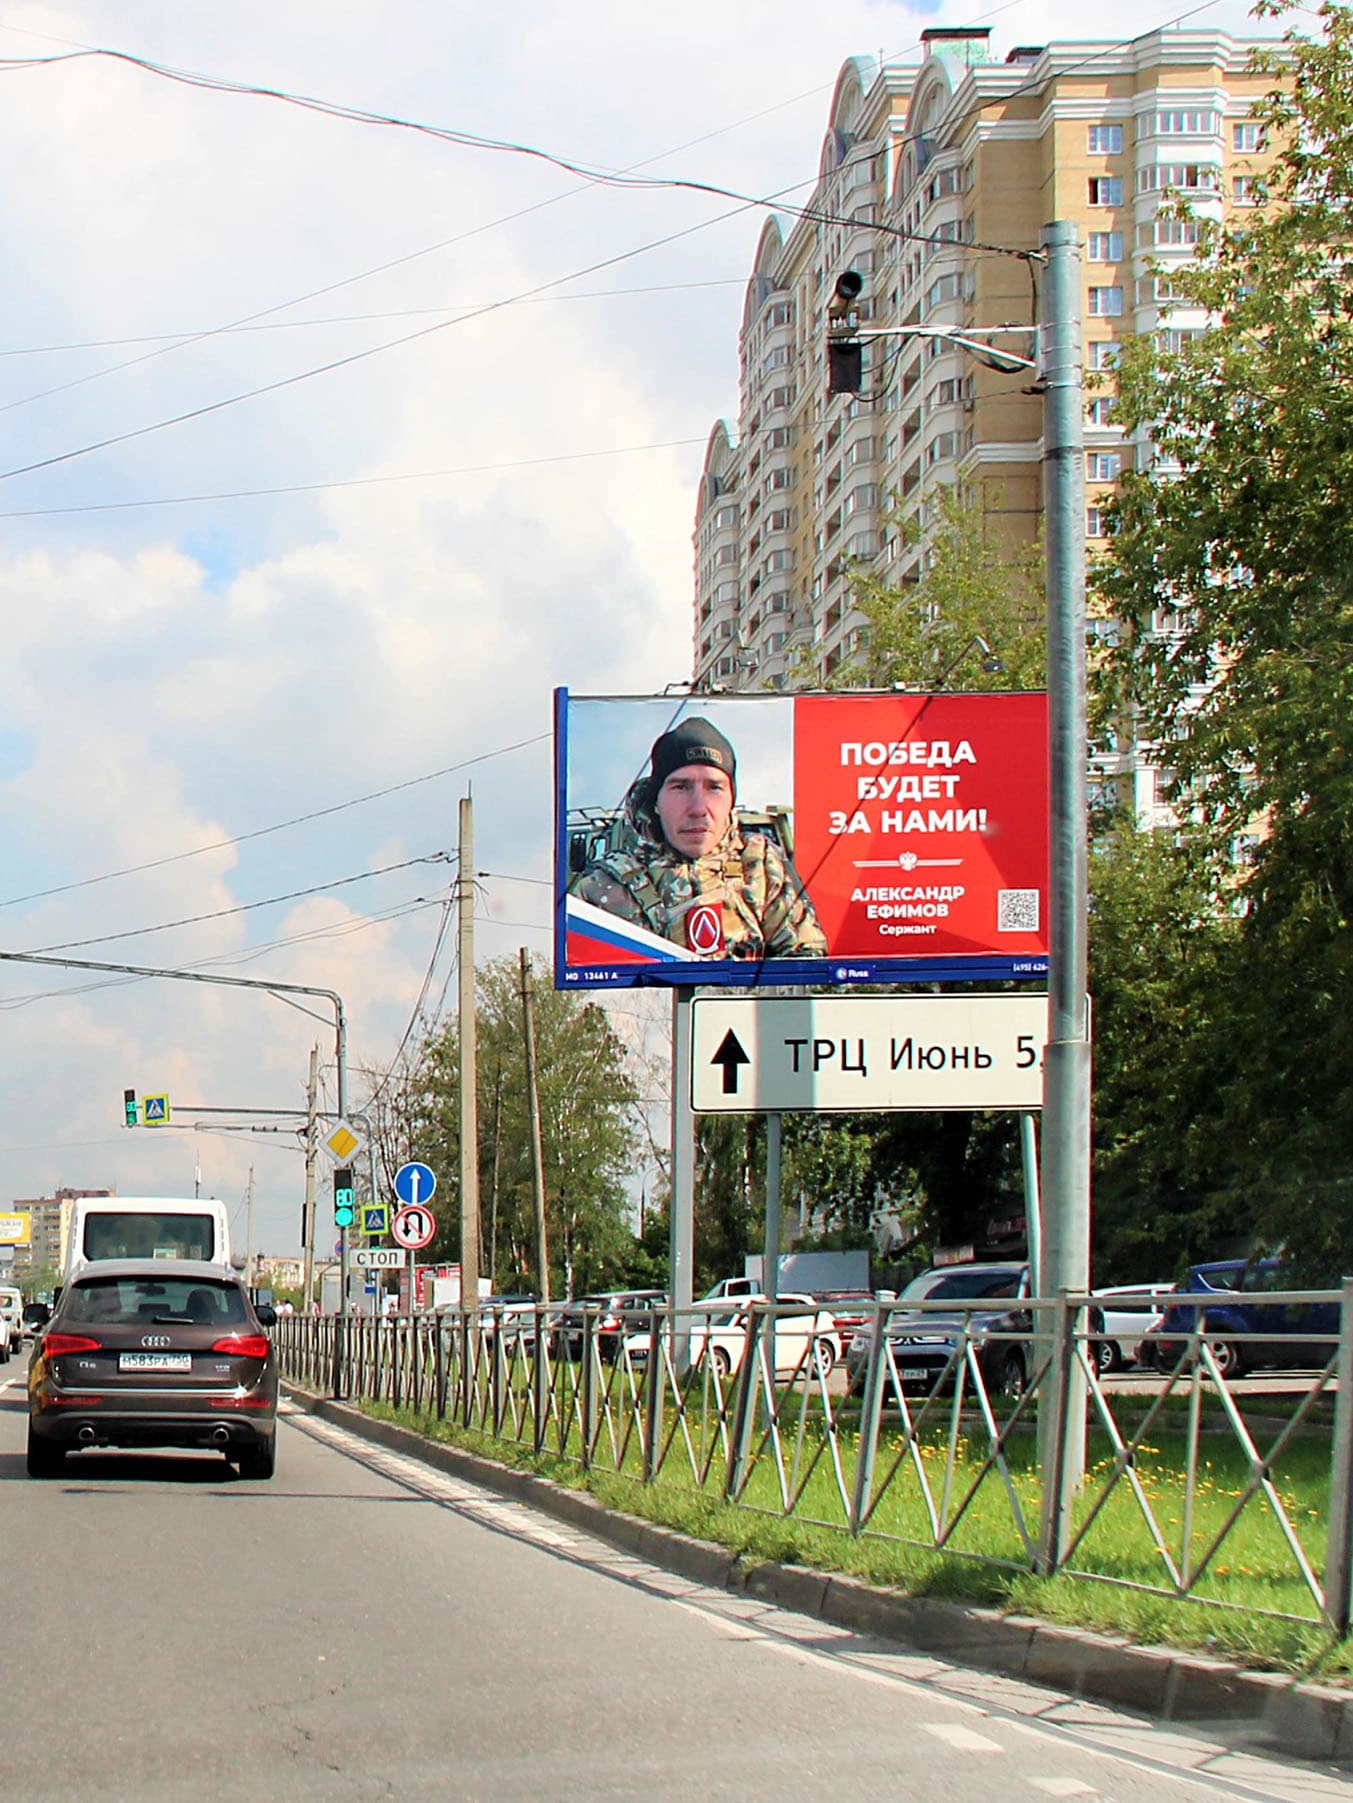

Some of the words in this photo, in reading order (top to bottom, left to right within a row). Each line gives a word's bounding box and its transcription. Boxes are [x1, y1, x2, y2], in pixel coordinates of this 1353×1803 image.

[840, 741, 976, 768] ПОБЕДА
[857, 775, 960, 802] БУДЕТ
[828, 811, 872, 834] ЗА
[881, 809, 987, 833] НАМИ!
[851, 886, 965, 902] АЛЕКСАНДР
[867, 904, 949, 919] ЕФИМОВ
[879, 924, 937, 936] Сержант
[848, 969, 869, 978] Russ
[785, 1039, 867, 1077] ТРЦ
[891, 1037, 992, 1070] Июнь
[336, 1188, 353, 1206] 80
[357, 1252, 398, 1265] СТОП
